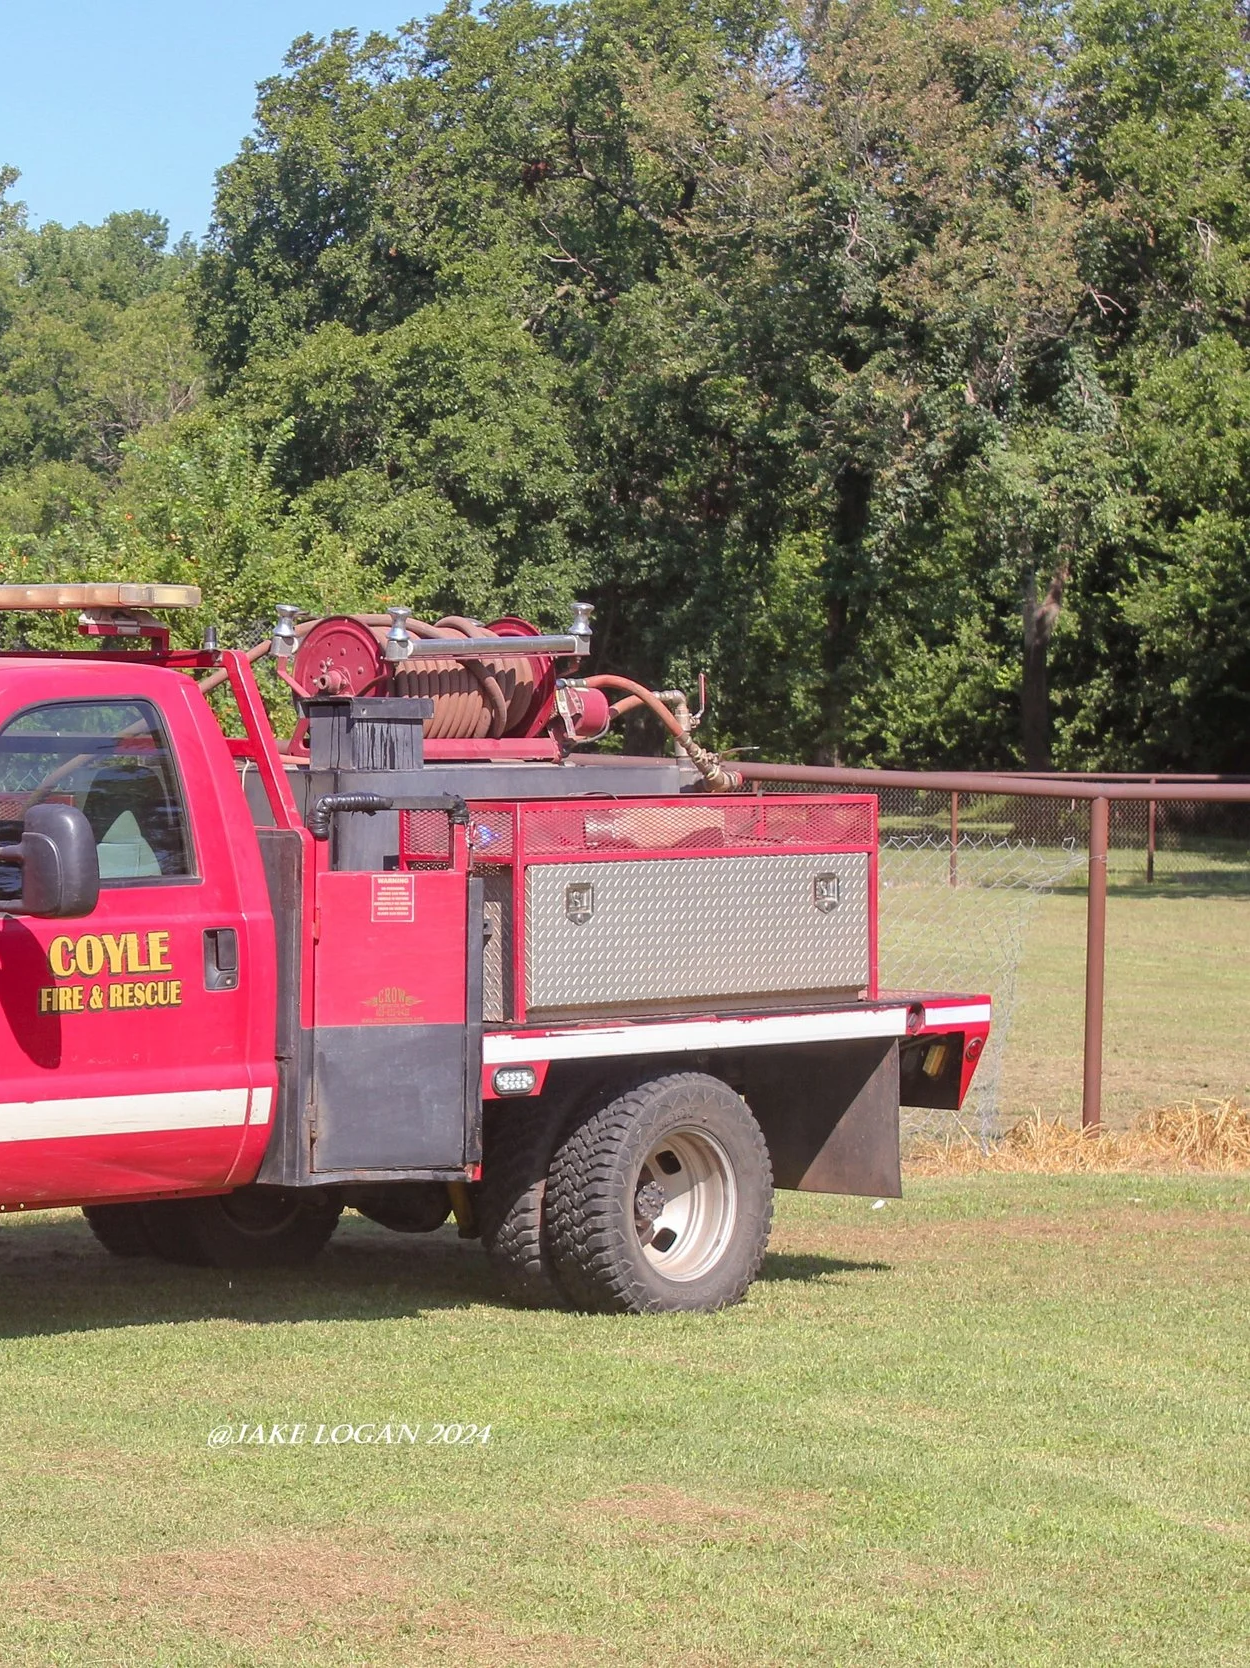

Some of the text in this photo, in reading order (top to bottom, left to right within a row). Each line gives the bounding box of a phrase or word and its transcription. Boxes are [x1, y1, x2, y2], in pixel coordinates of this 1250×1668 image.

[49, 931, 173, 978] COYLE
[39, 980, 182, 1014] FIRE & RESCUE
[378, 986, 406, 1004] CROW
